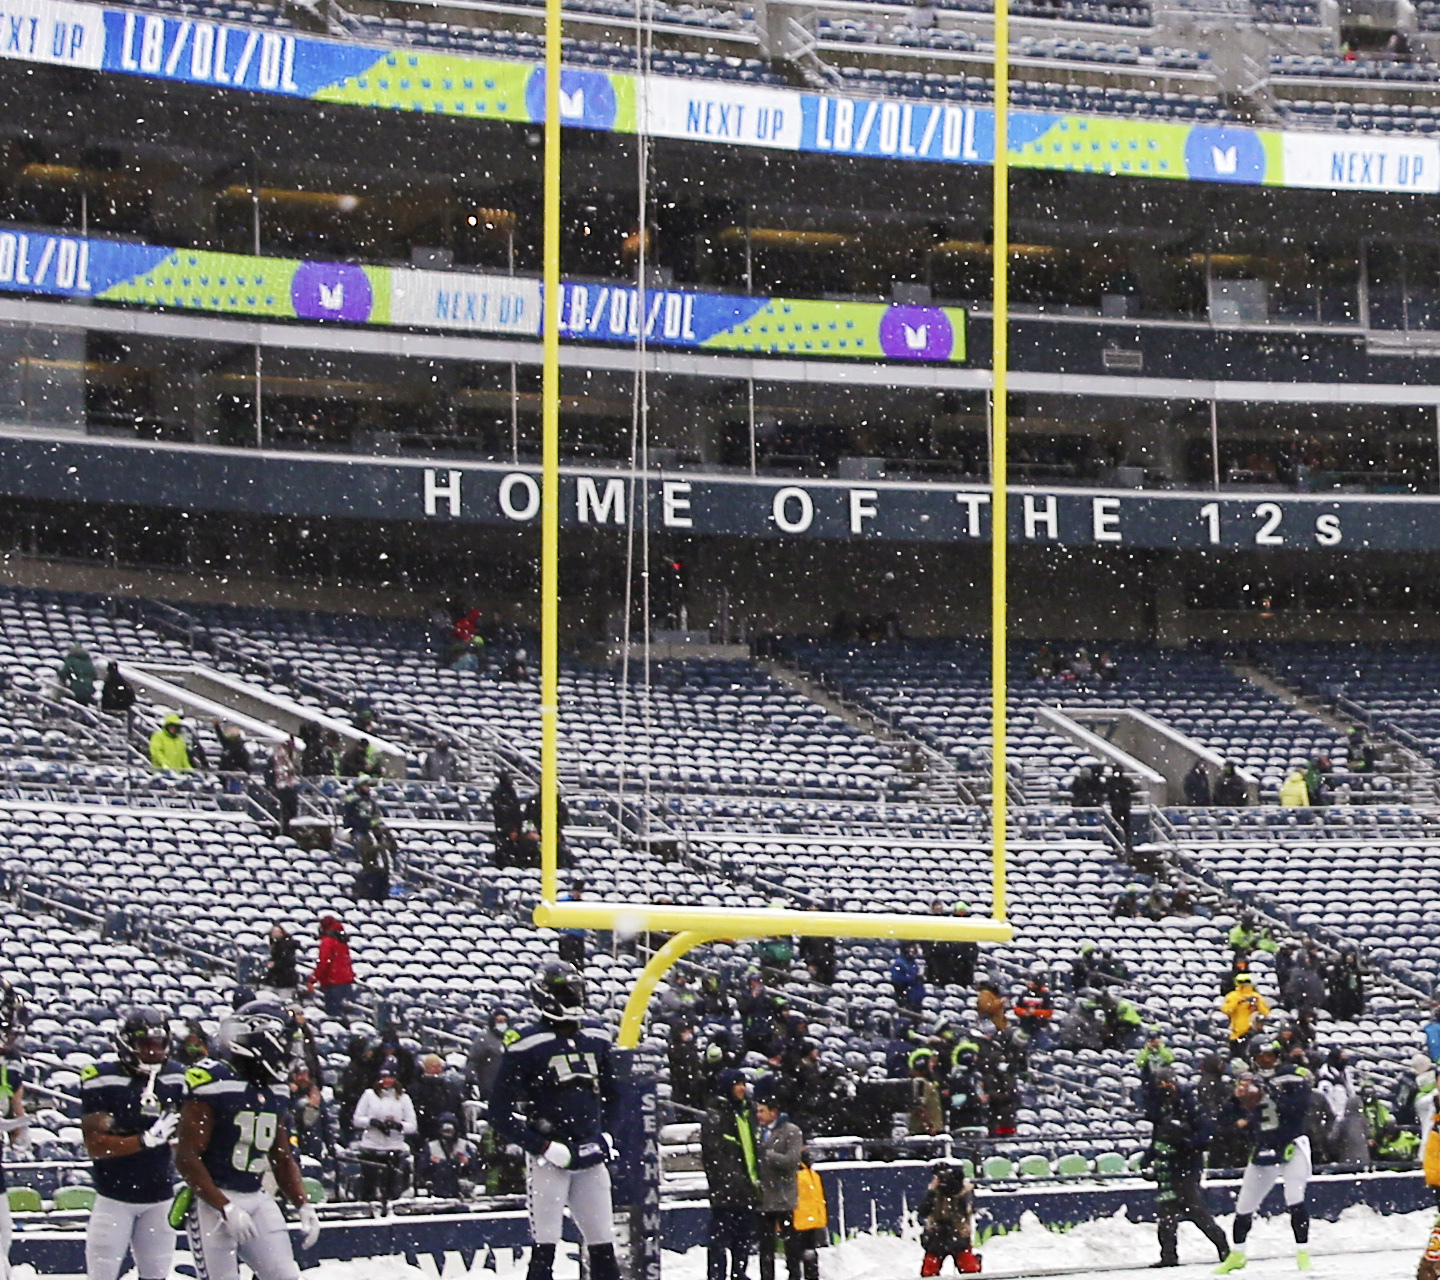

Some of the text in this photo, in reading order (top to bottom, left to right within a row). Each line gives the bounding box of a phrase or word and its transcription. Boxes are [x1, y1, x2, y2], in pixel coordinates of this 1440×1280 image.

[51, 19, 85, 57] UP
[121, 11, 298, 93] LB/OL/DL
[686, 96, 980, 161] NEXT UP LB/OL/DL
[1330, 150, 1389, 183] NEXT
[1397, 153, 1425, 185] UP
[435, 283, 695, 340] NEXT UP LB/OL/DL
[423, 467, 1344, 547] HOME OF THE 12s
[232, 1111, 278, 1173] 19
